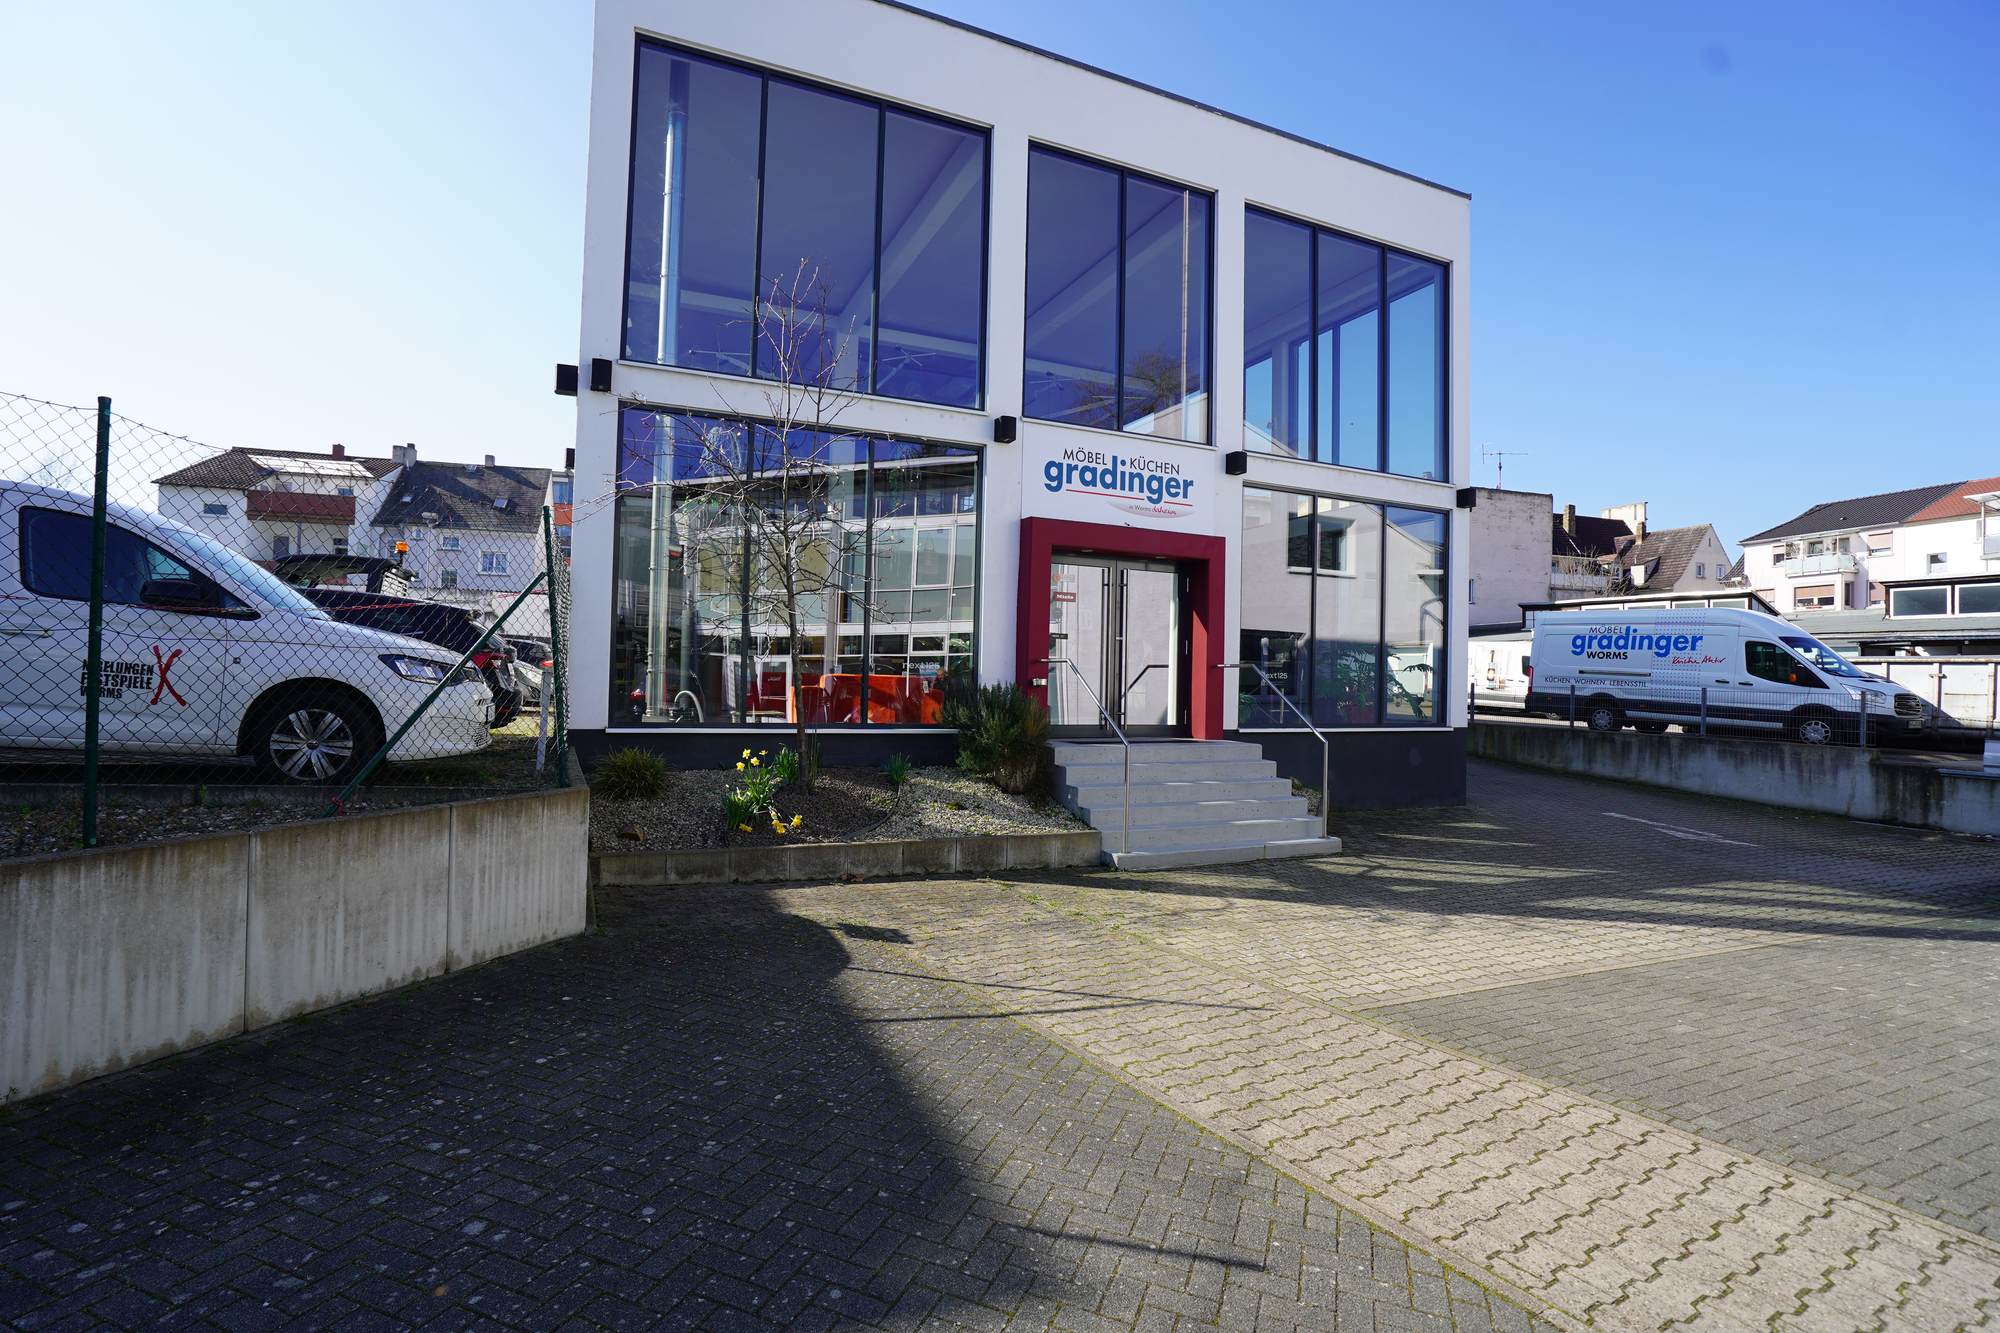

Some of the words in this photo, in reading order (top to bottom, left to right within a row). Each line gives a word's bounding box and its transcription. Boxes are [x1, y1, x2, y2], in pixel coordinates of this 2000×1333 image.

[1063, 447, 1107, 466] MÖBEL
[1129, 456, 1180, 476] KÜCHEN
[1044, 455, 1194, 505] gradinger
[1571, 625, 1703, 658] gradinger
[1586, 651, 1628, 660] WORMS
[82, 659, 154, 677] NELUNGEN
[1260, 671, 1288, 680] ext125
[80, 671, 153, 690] FTSPIELE
[80, 685, 123, 699] WRMS
